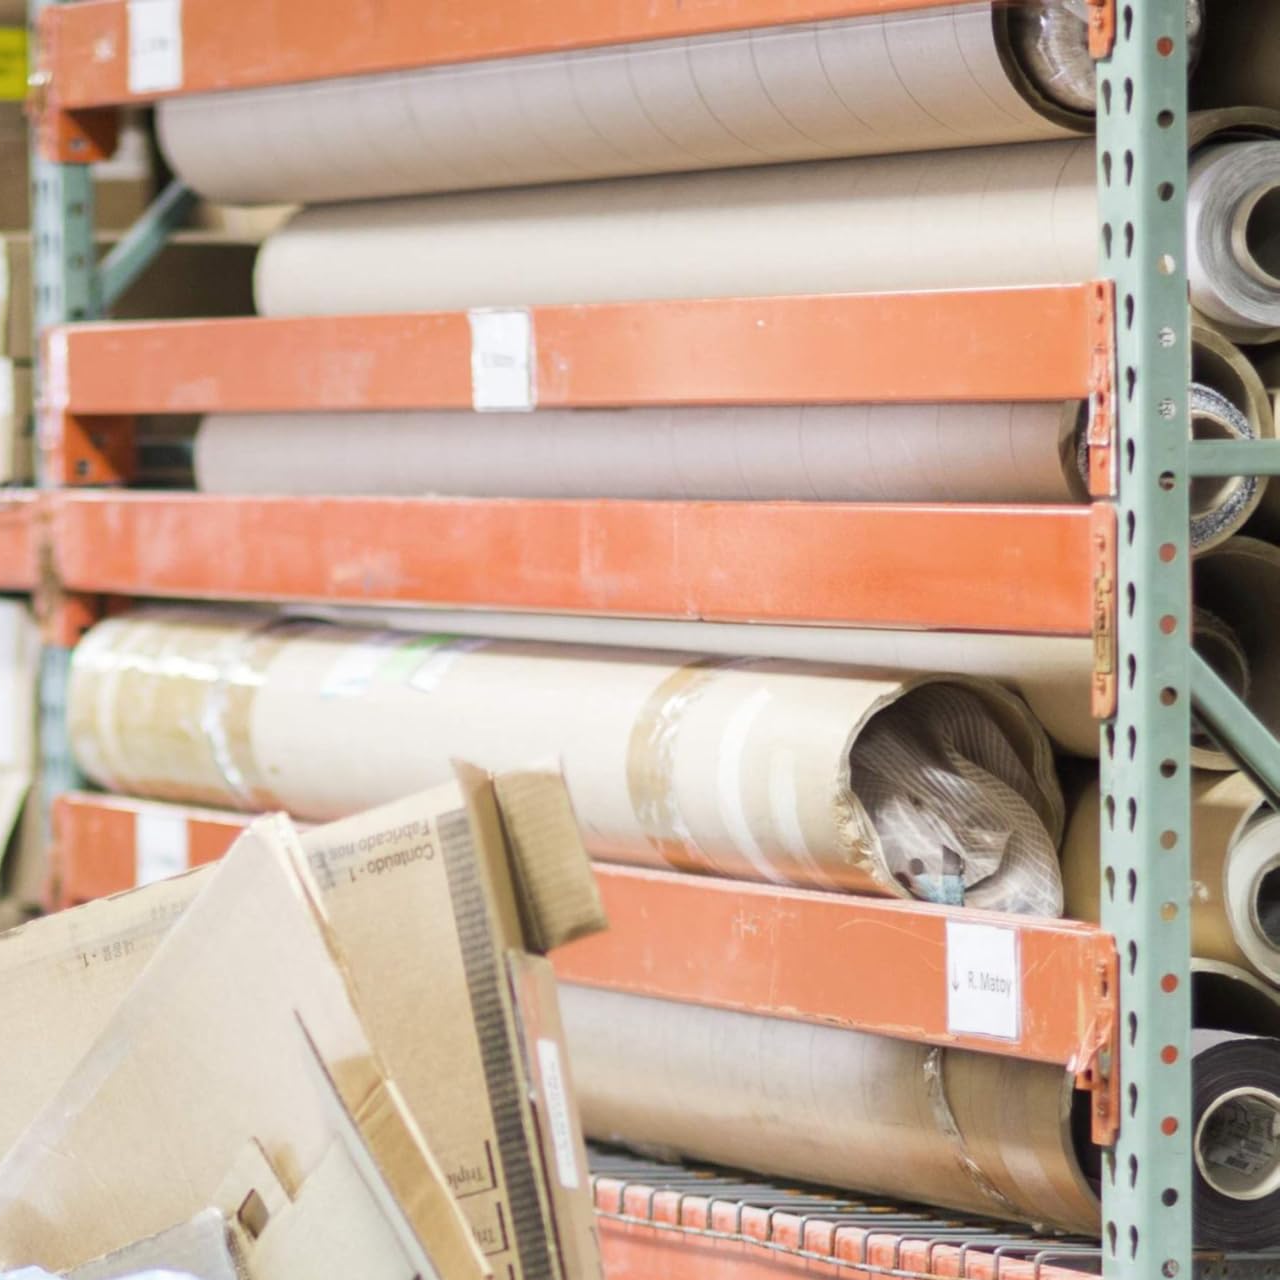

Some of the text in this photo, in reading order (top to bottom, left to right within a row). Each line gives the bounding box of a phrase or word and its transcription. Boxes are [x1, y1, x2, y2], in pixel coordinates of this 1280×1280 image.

[358, 820, 431, 852] Fabricado
[349, 867, 357, 882] 1
[967, 970, 978, 990] R.
